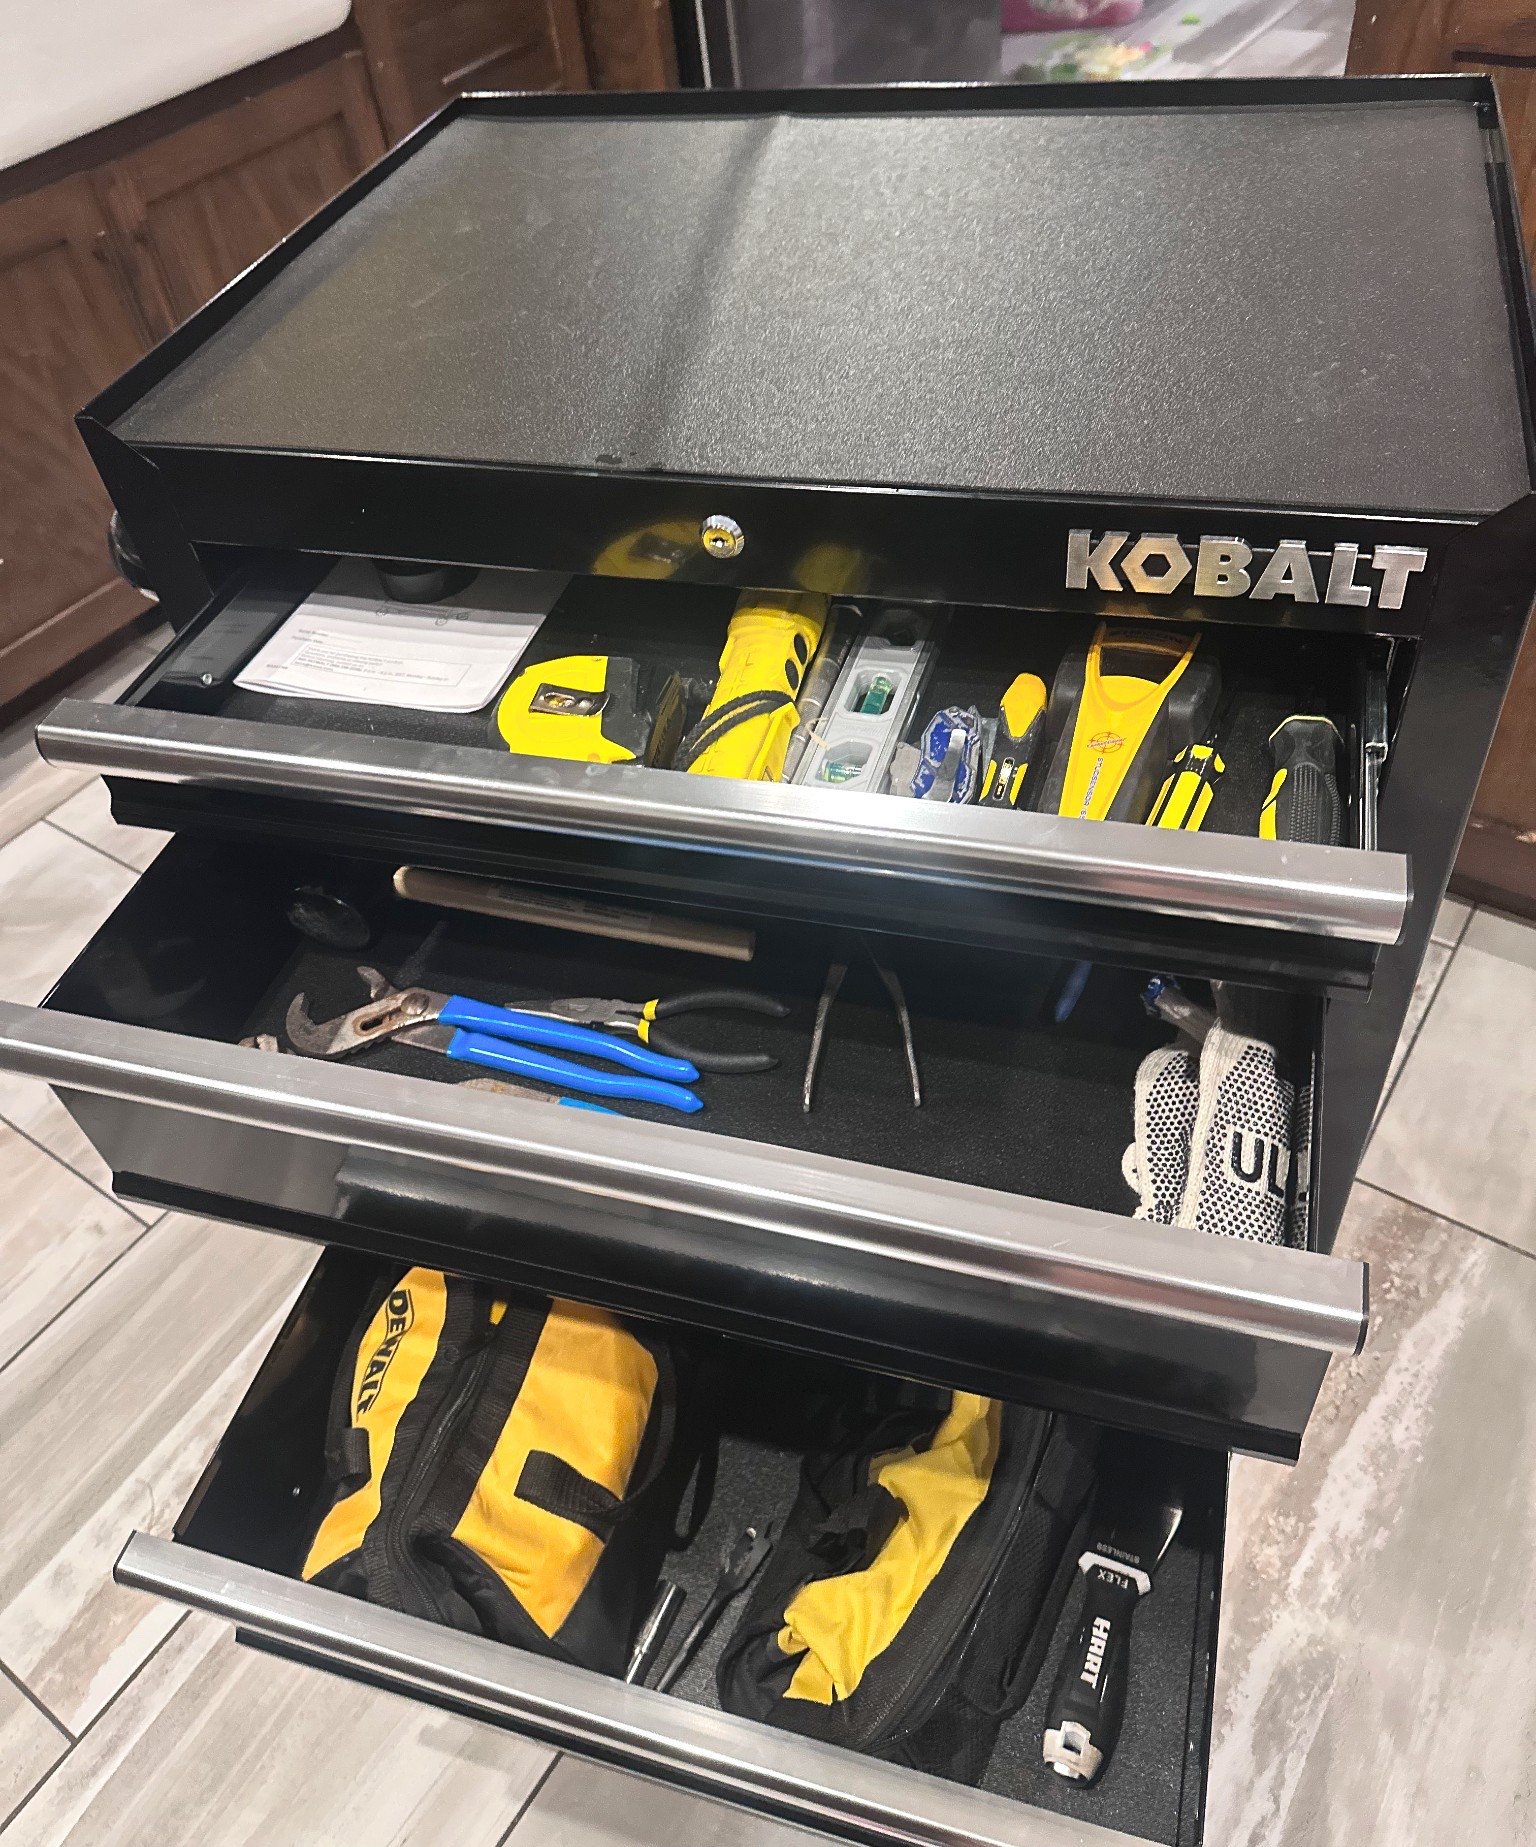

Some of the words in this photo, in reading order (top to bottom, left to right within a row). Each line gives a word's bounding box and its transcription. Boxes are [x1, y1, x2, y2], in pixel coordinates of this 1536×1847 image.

[1065, 529, 1428, 609] KOBALT
[1084, 757, 1103, 806] STUDSENSOR
[357, 1289, 409, 1414] DEWALT
[1097, 1569, 1129, 1589] FLEX
[1080, 1616, 1111, 1690] HART
